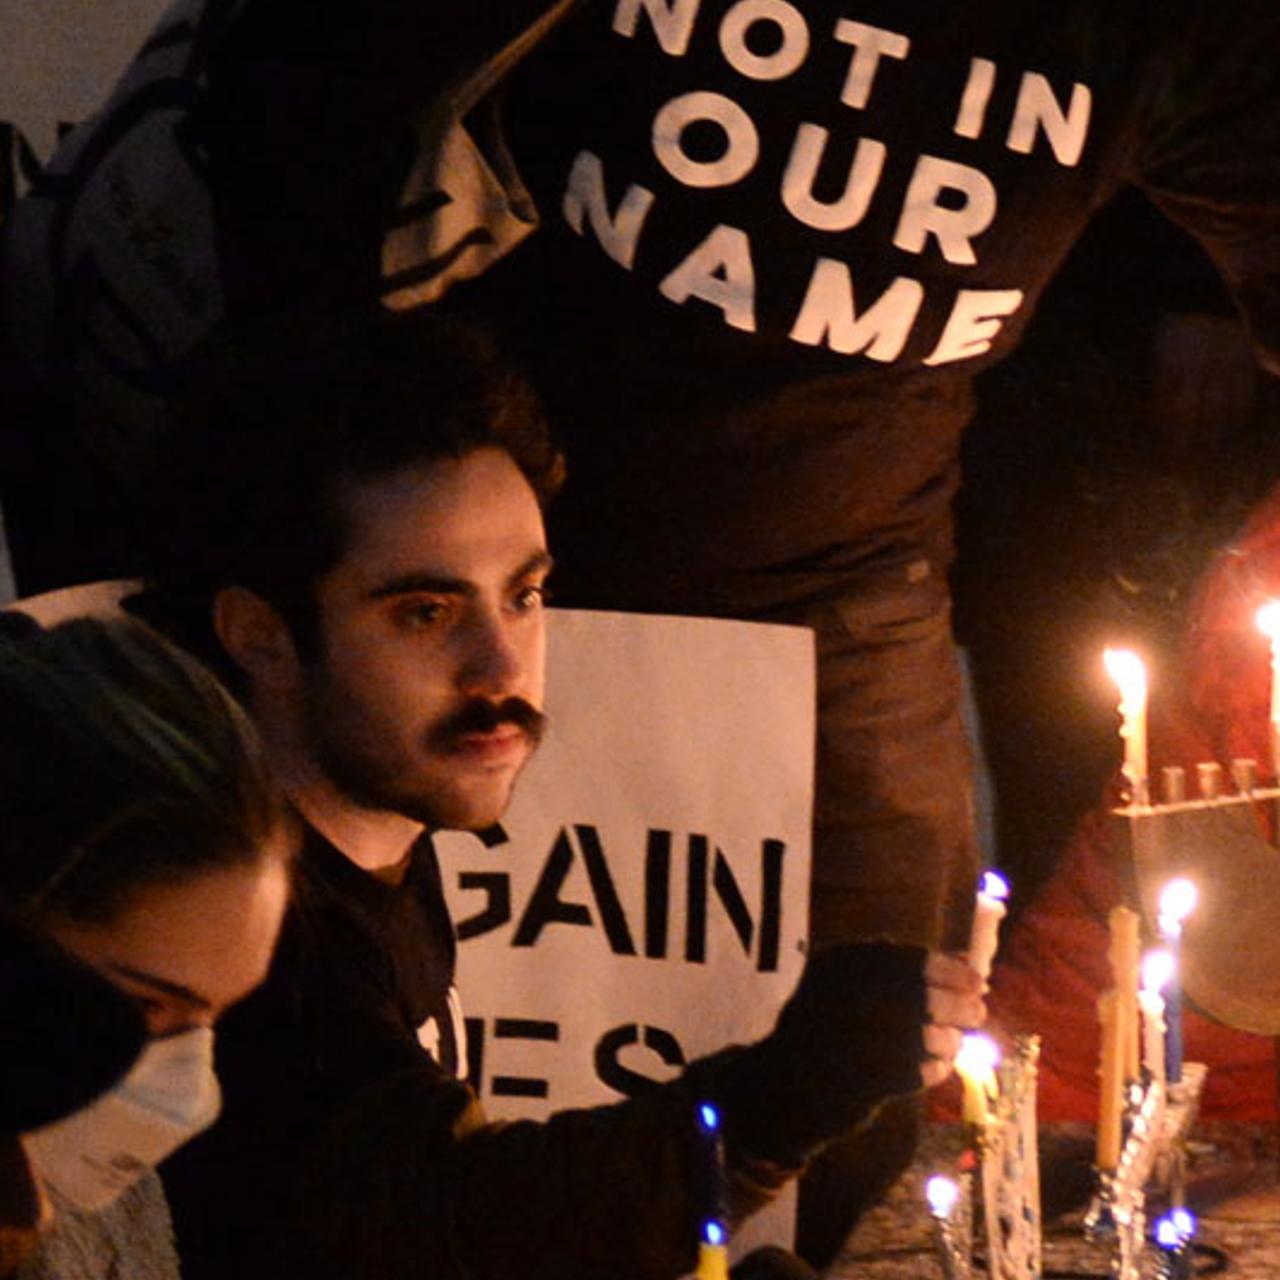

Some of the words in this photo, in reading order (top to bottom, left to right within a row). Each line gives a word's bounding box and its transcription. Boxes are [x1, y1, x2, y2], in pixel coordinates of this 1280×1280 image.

[650, 89, 998, 266] OUR
[952, 56, 1093, 169] IN
[562, 147, 1025, 367] NAME
